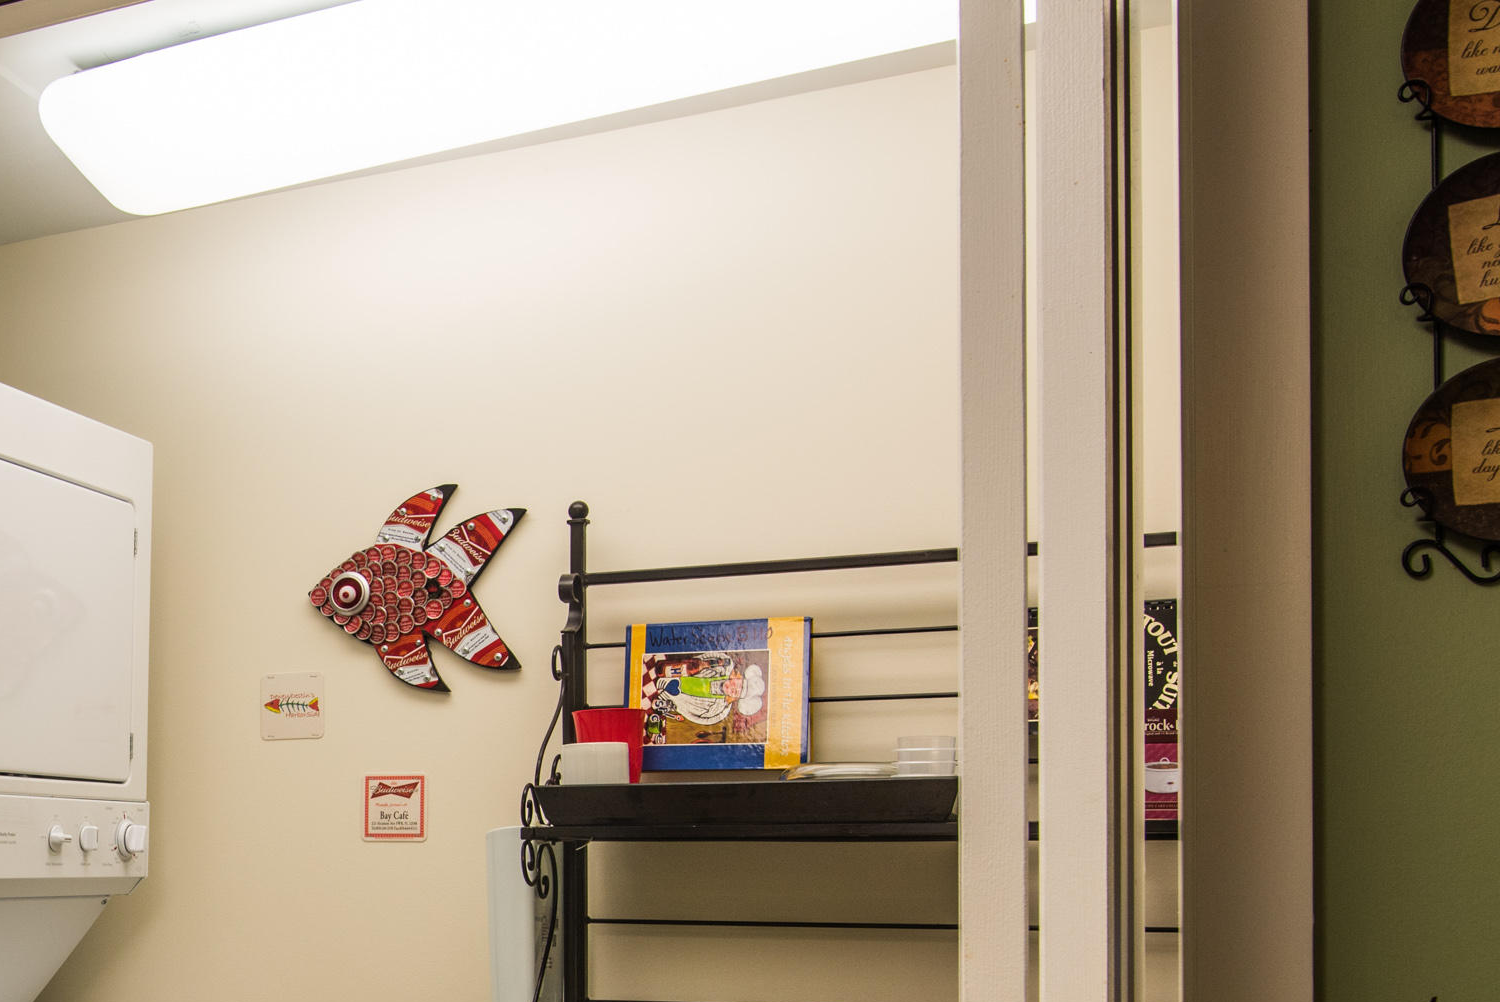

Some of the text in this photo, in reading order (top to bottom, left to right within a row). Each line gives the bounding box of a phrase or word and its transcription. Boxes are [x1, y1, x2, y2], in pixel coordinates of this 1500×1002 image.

[1461, 39, 1489, 59] like
[1467, 236, 1493, 255] like
[650, 624, 687, 648] Water
[1147, 650, 1155, 687] Microwave
[1145, 718, 1171, 731] rock
[380, 810, 409, 822] Bay Café
